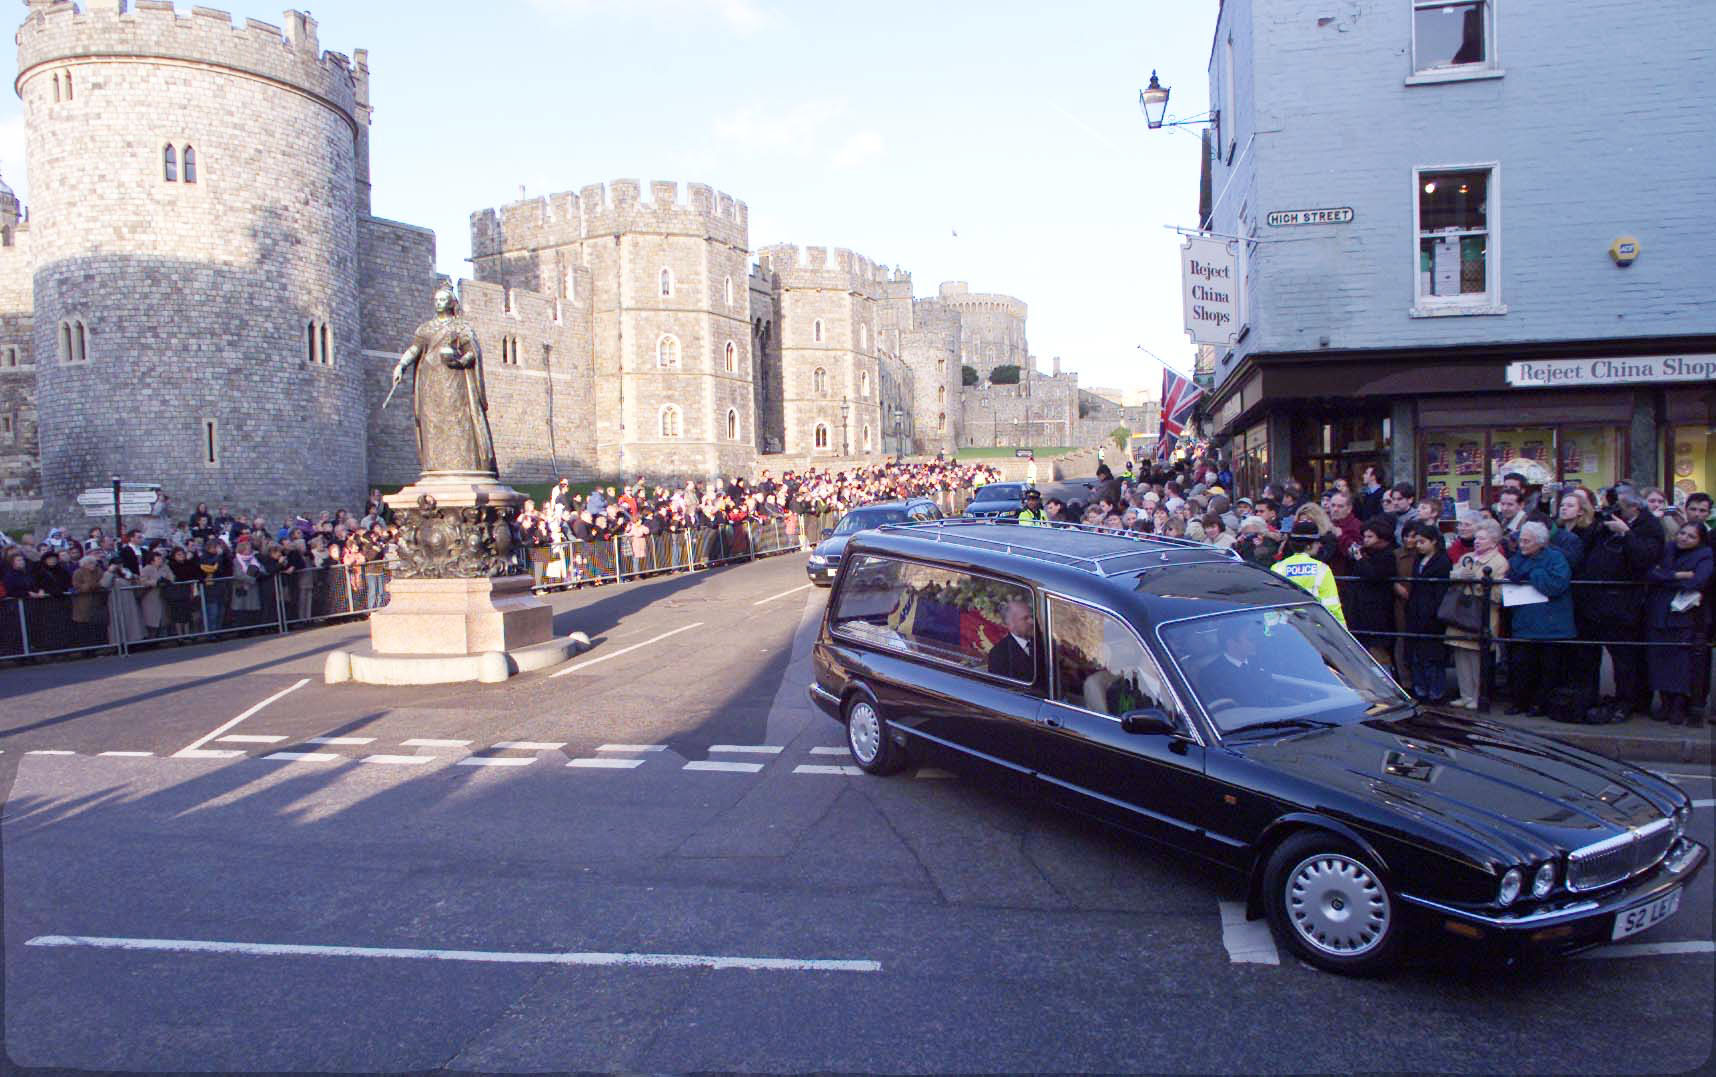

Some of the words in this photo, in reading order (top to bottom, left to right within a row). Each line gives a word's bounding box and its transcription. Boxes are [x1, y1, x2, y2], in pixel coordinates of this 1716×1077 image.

[1271, 213, 1298, 224] HIGH
[1303, 210, 1350, 222] STREET
[1190, 260, 1230, 280] Reject
[1192, 285, 1230, 303] China
[1193, 305, 1231, 326] Shops
[1520, 364, 1584, 383] Reject
[1590, 360, 1653, 378] China
[1286, 565, 1317, 576] POLICE
